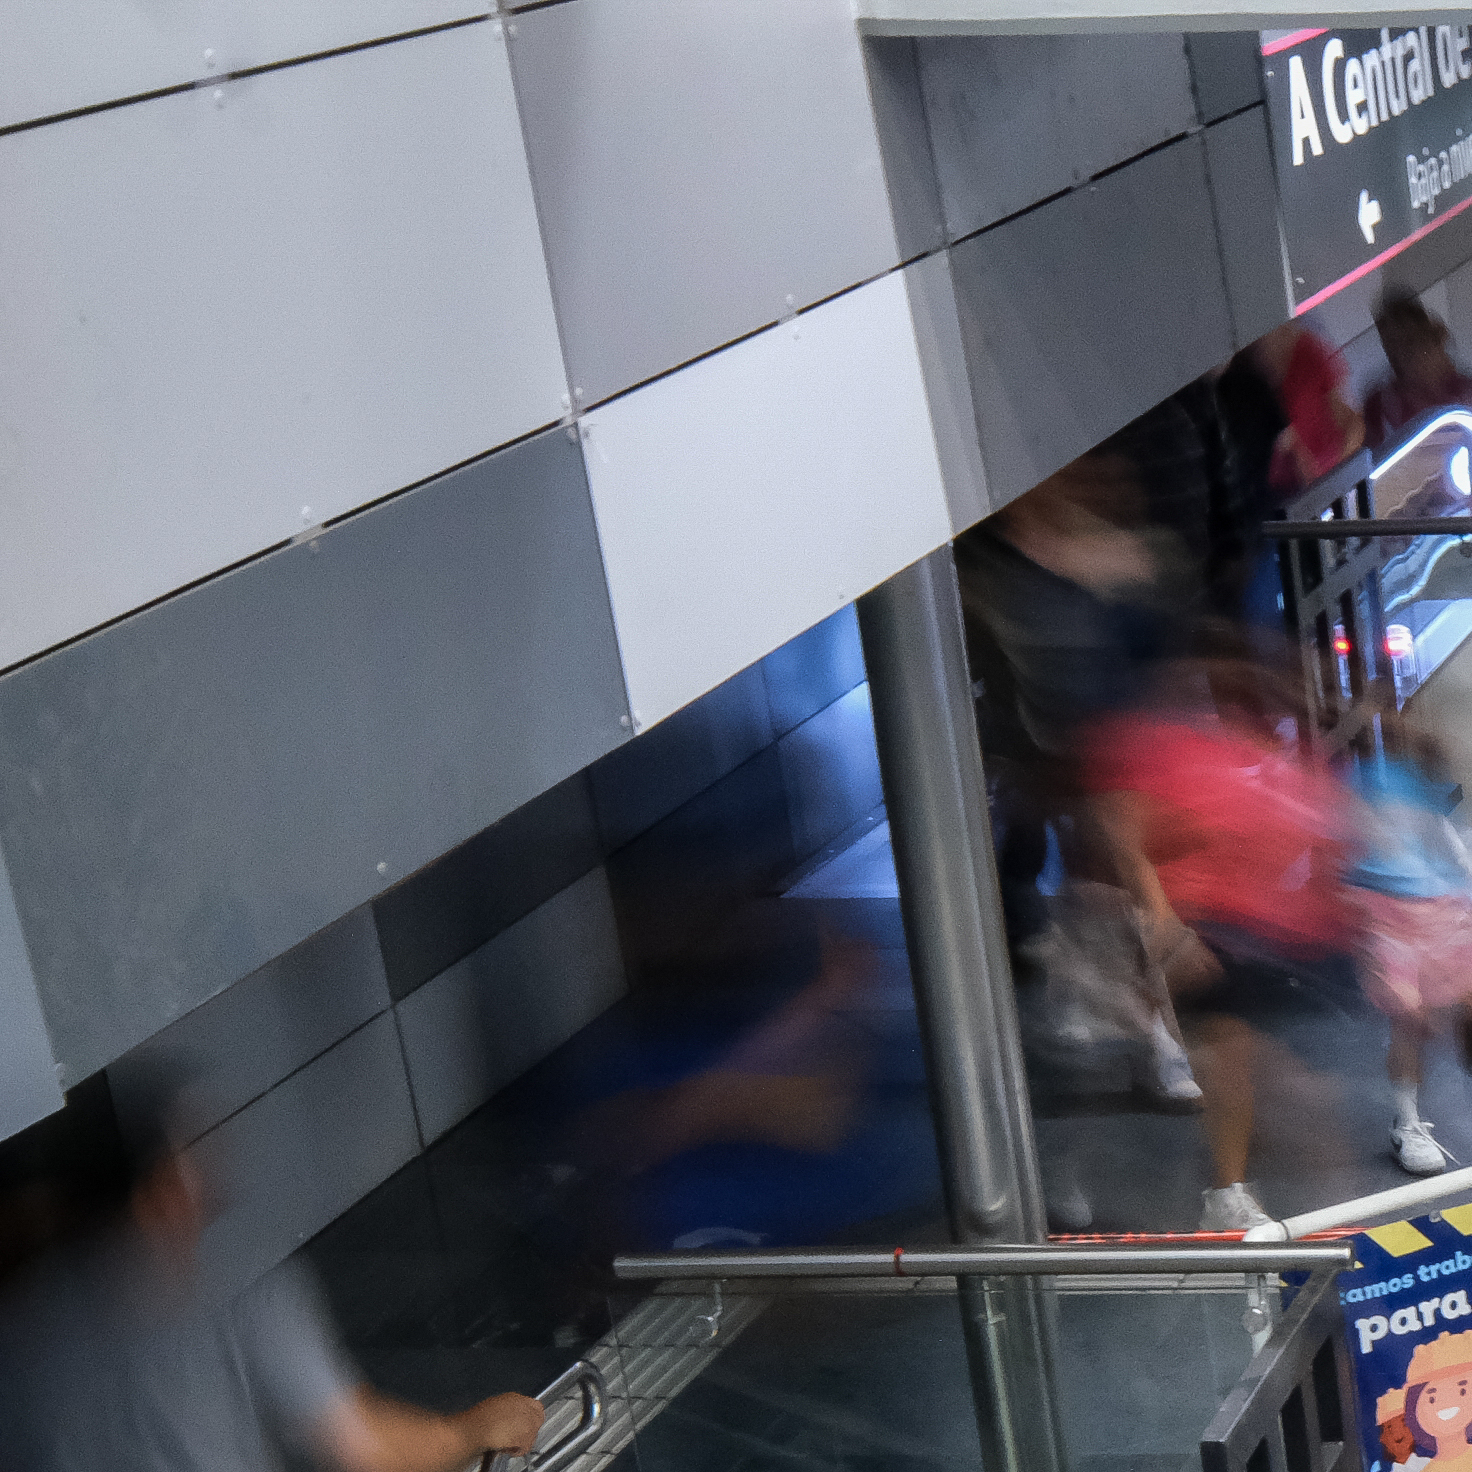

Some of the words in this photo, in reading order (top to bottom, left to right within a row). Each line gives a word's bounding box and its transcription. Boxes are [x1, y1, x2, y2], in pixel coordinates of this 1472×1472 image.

[1289, 55, 1324, 166] A
[1322, 26, 1434, 144] Central
[1339, 1273, 1415, 1306] amos
[1355, 1289, 1472, 1354] para
